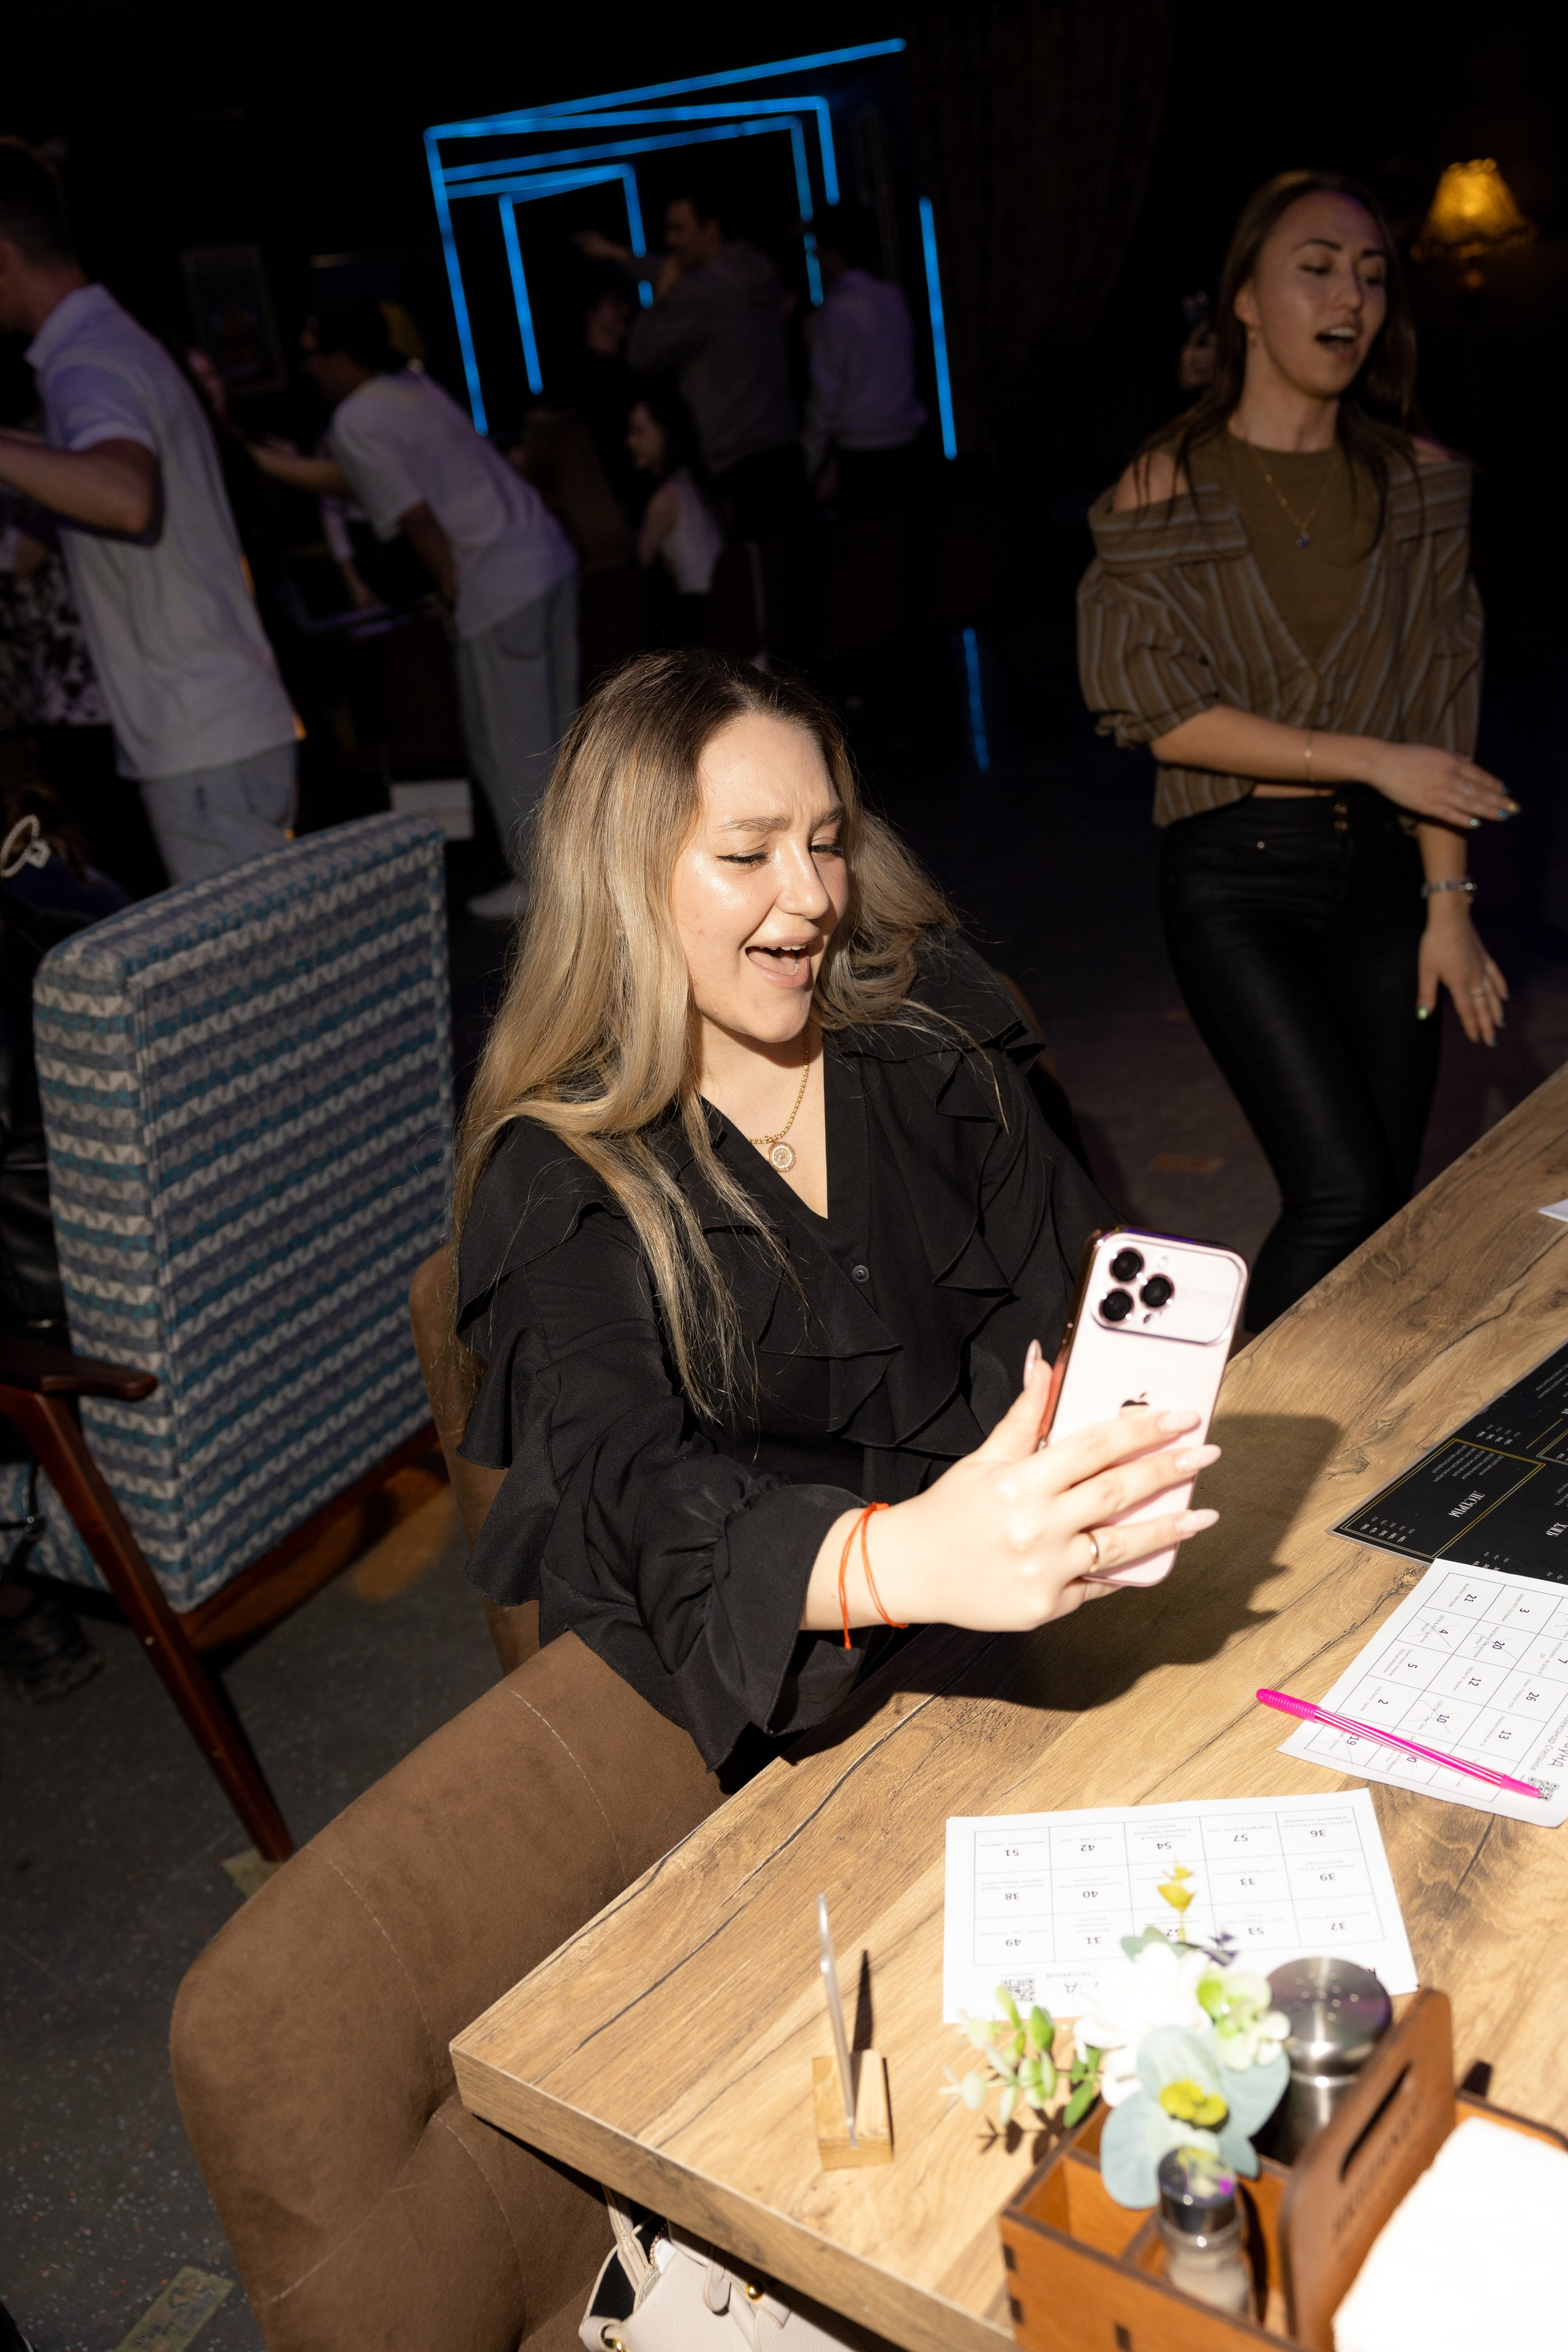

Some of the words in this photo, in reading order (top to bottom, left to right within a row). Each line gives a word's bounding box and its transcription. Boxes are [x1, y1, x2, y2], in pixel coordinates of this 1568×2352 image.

[1454, 1444, 1468, 1455] ДЕСЕРТ
[1463, 1447, 1477, 1458] ДЕСЕРТ
[1472, 1449, 1487, 1461] ДЕСЕРТ
[1481, 1452, 1496, 1463] ДЕСЕРТ
[1490, 1454, 1505, 1466] ДЕСЕРТ
[1452, 1459, 1475, 1477] МОРКОВНЫЙ
[1461, 1461, 1484, 1480] МАЛИНОВЫЙ
[1448, 1490, 1486, 1518] ДЕСЕРТЫ
[1545, 1522, 1568, 1537] ХЛЕБ
[1463, 1594, 1477, 1602] 21
[1515, 1593, 1525, 1602] ANNA
[1491, 1640, 1506, 1650] 20
[1403, 1648, 1414, 1658] Cream
[1468, 1677, 1482, 1687] 12
[1525, 1692, 1540, 1702] 26
[1436, 1714, 1450, 1724] 10
[1547, 1714, 1568, 1744] лександр
[1498, 1730, 1512, 1740] 13
[1346, 1735, 1360, 1746] 19
[1406, 1754, 1419, 1763] 0
[1529, 1744, 1554, 1771] Степанов
[1232, 1833, 1249, 1842] 57
[1309, 1828, 1327, 1838] 36
[1079, 1843, 1095, 1852] 42
[1155, 1841, 1172, 1850] 54
[1004, 1849, 1019, 1857] 51
[1239, 1877, 1256, 1886] 33
[1318, 1872, 1336, 1881] 39
[1004, 1891, 1020, 1901] 38
[1082, 1890, 1098, 1899] 40
[1246, 1926, 1264, 1936] 53
[1329, 1921, 1347, 1931] 37
[1005, 1938, 1021, 1947] 49
[1085, 1936, 1101, 1945] 31
